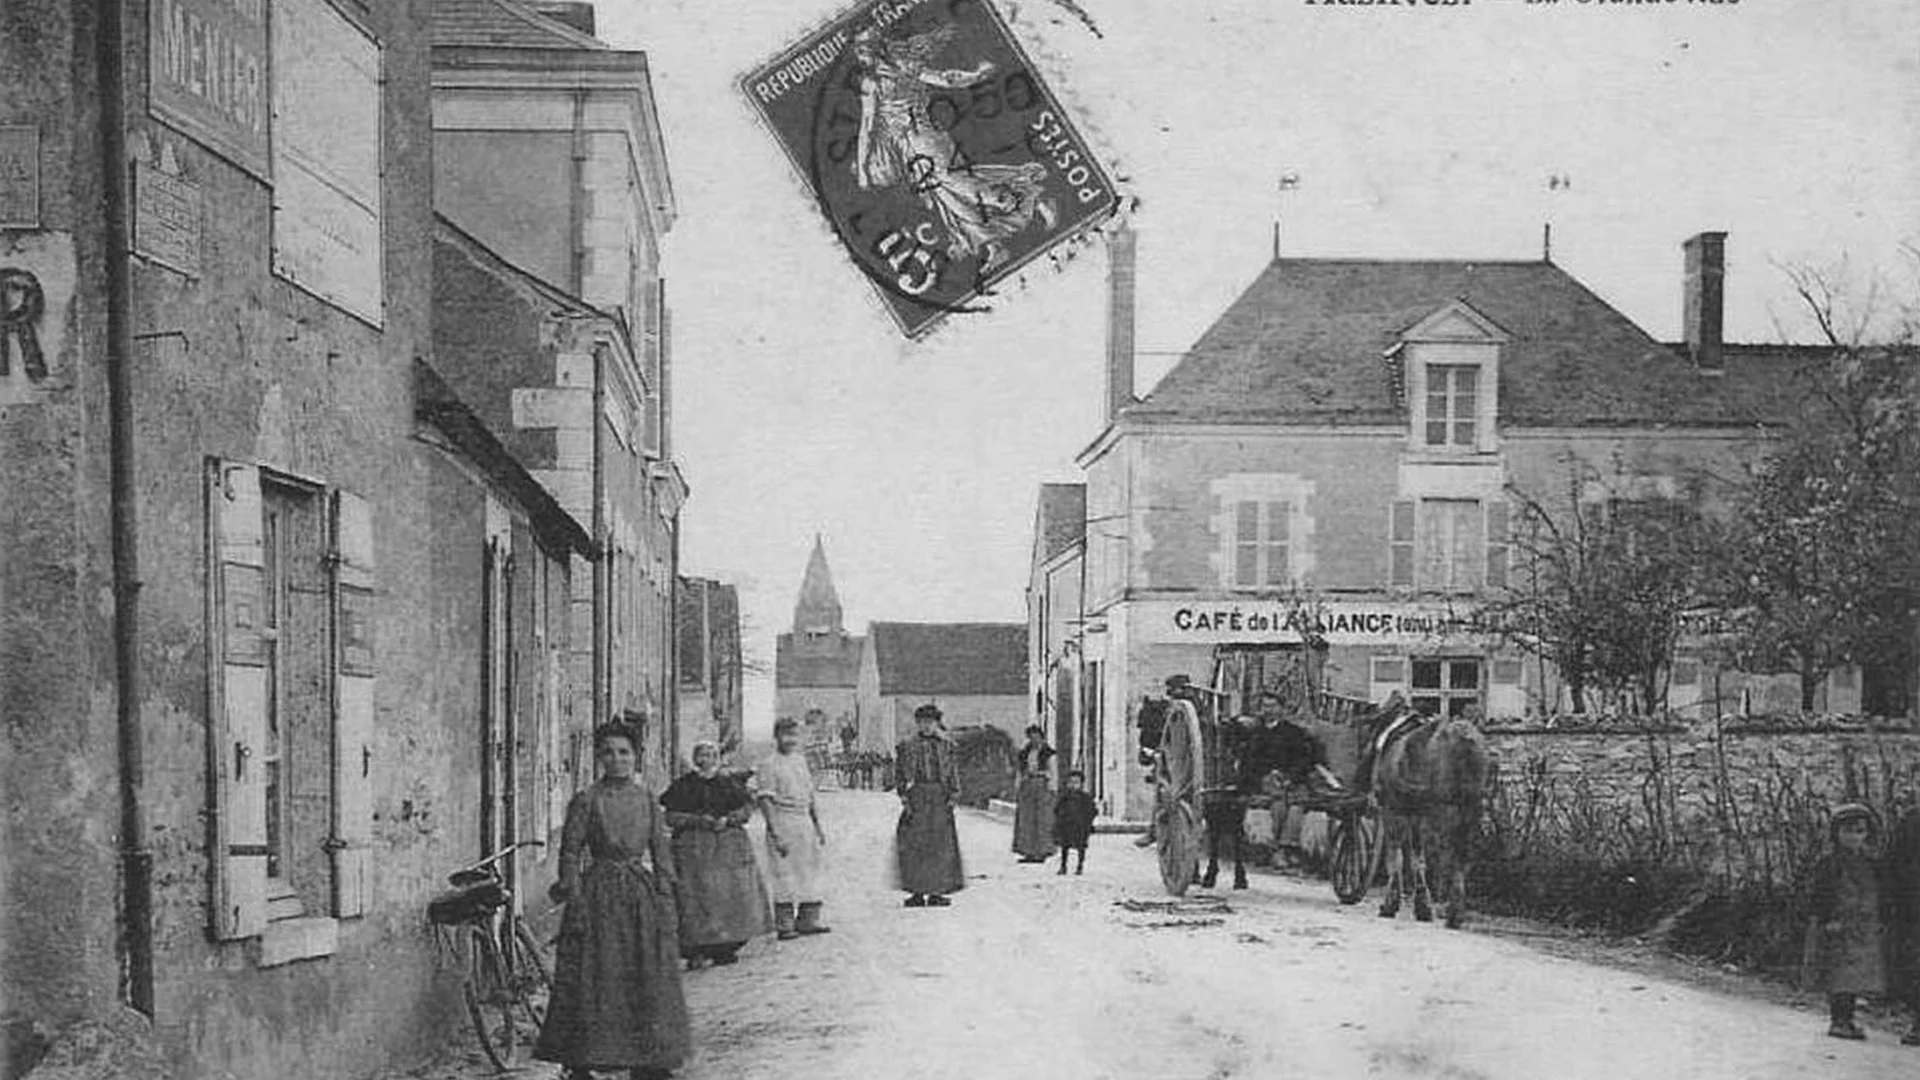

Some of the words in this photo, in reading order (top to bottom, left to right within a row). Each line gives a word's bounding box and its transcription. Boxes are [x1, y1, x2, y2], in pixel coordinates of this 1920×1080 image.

[1031, 110, 1101, 203] POSTES
[1174, 605, 1243, 631] CAFÉ
[1247, 612, 1269, 631] de
